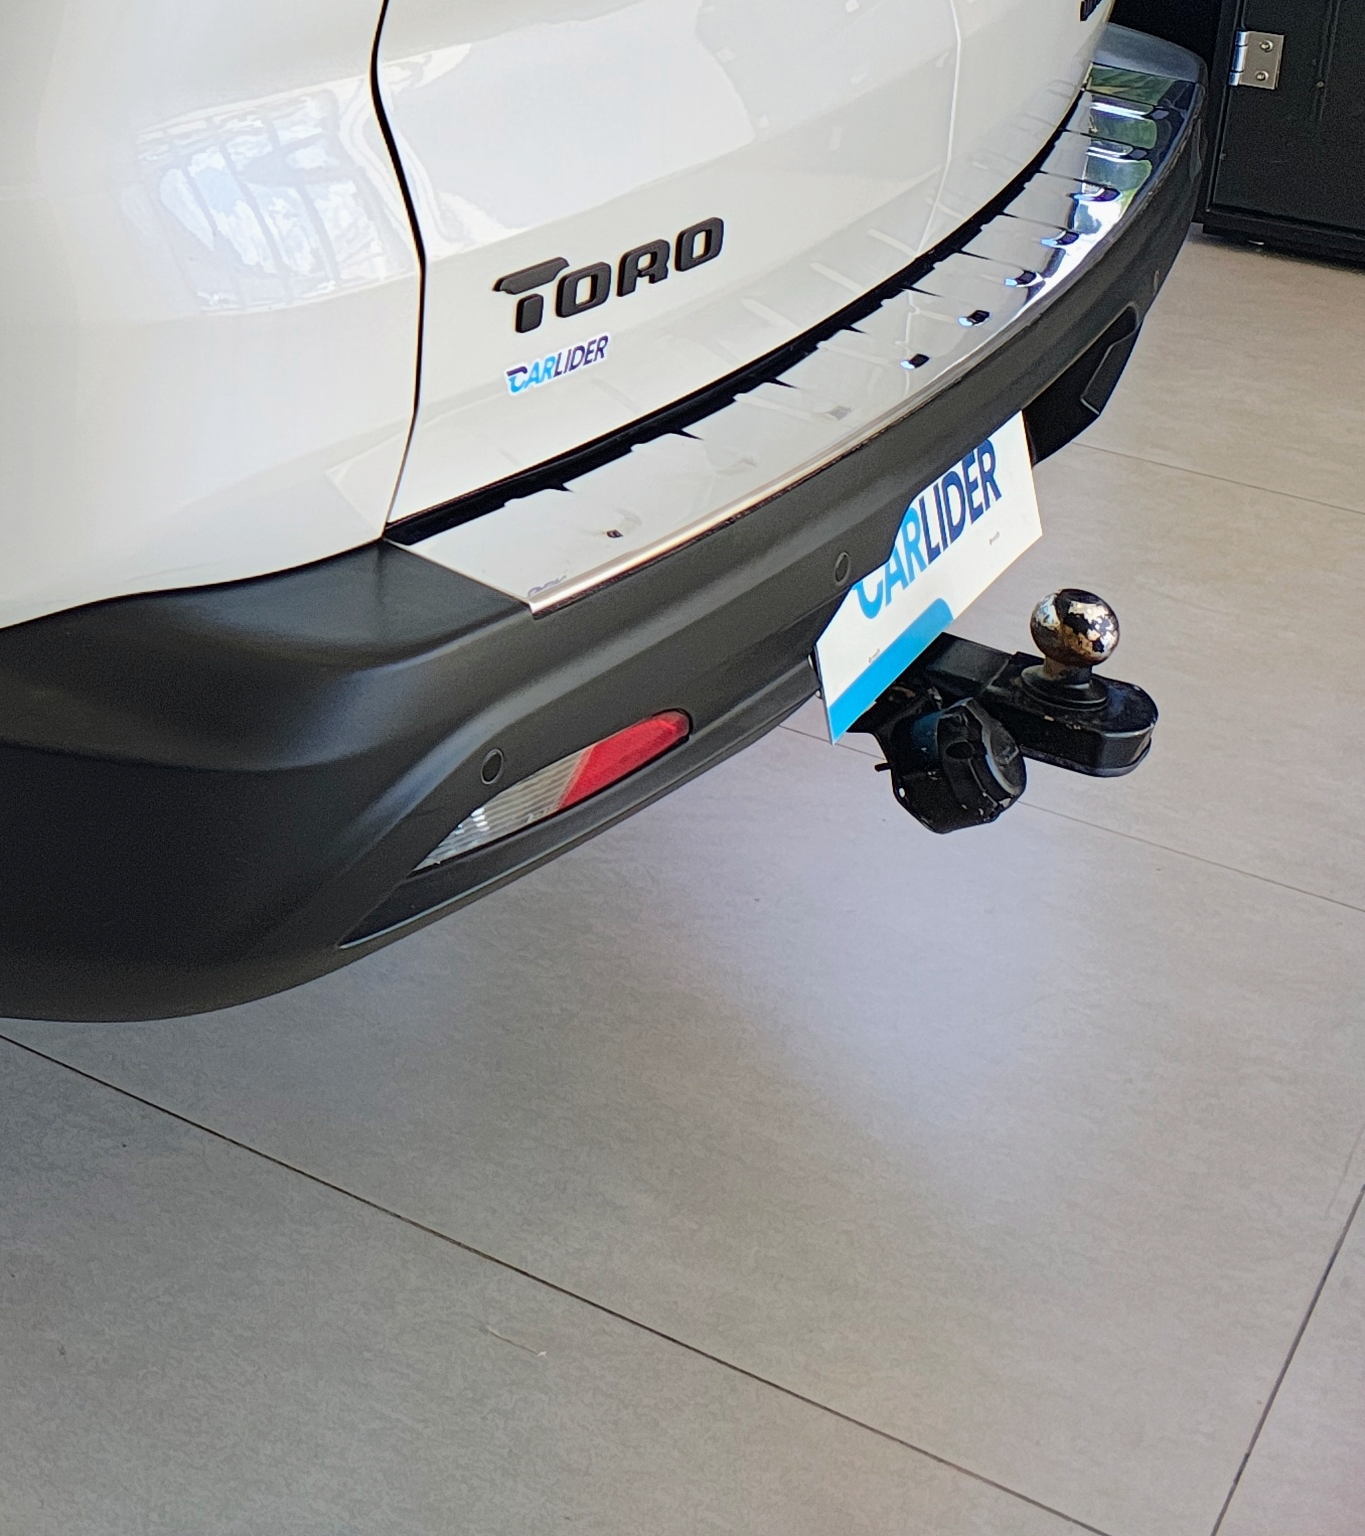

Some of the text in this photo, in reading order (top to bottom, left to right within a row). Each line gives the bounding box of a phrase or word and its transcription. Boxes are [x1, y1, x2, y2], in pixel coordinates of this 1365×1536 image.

[492, 217, 725, 333] TORO
[506, 335, 609, 393] CARLIDER
[853, 437, 1003, 620] CARLIDER
